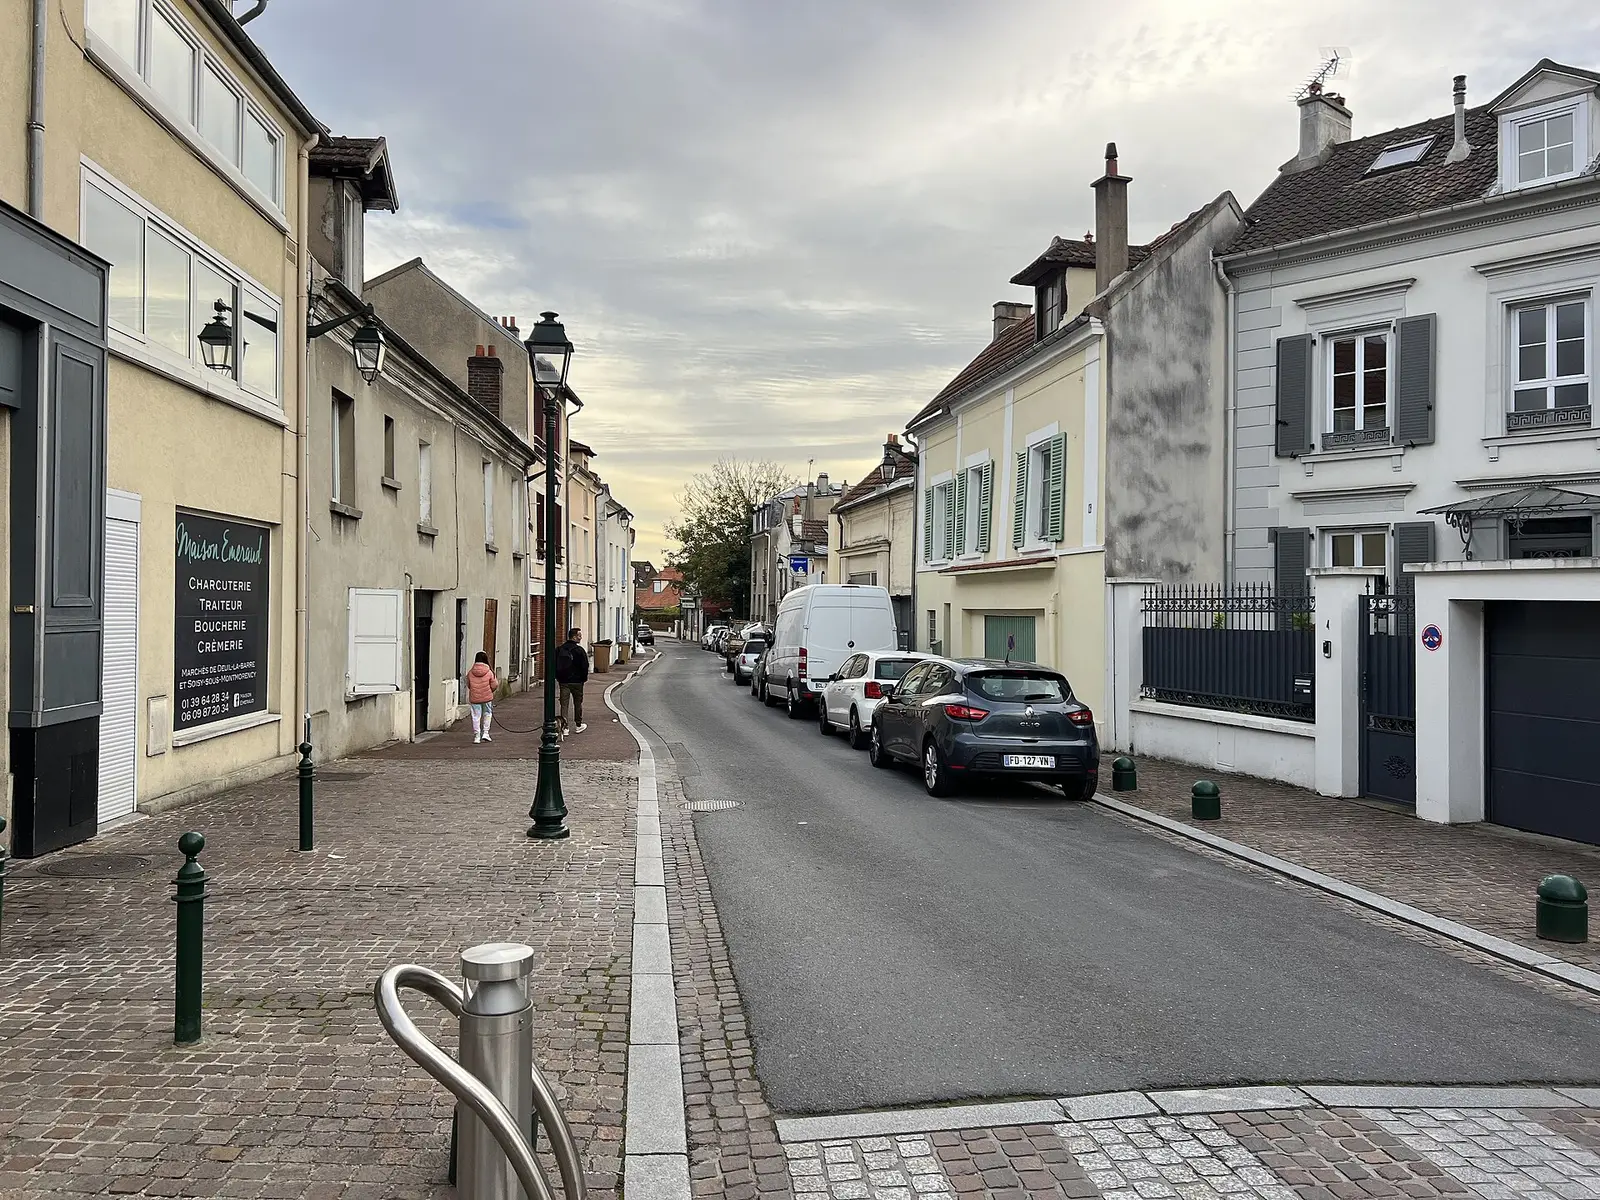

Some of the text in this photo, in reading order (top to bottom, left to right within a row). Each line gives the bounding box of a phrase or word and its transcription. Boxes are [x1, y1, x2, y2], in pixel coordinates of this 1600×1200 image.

[176, 522, 263, 565] Maison Emeraud
[188, 577, 252, 592] CHARCUTERIE
[199, 598, 243, 611] TRAITEUR
[194, 620, 247, 633] BOUCHERIE
[197, 638, 244, 654] CRÈMERIE
[179, 681, 187, 690] ET
[181, 691, 229, 709] 01 39 64 28 34
[181, 703, 229, 722] 06 09 87 20 34
[1009, 755, 1049, 766] FD-127-VN
